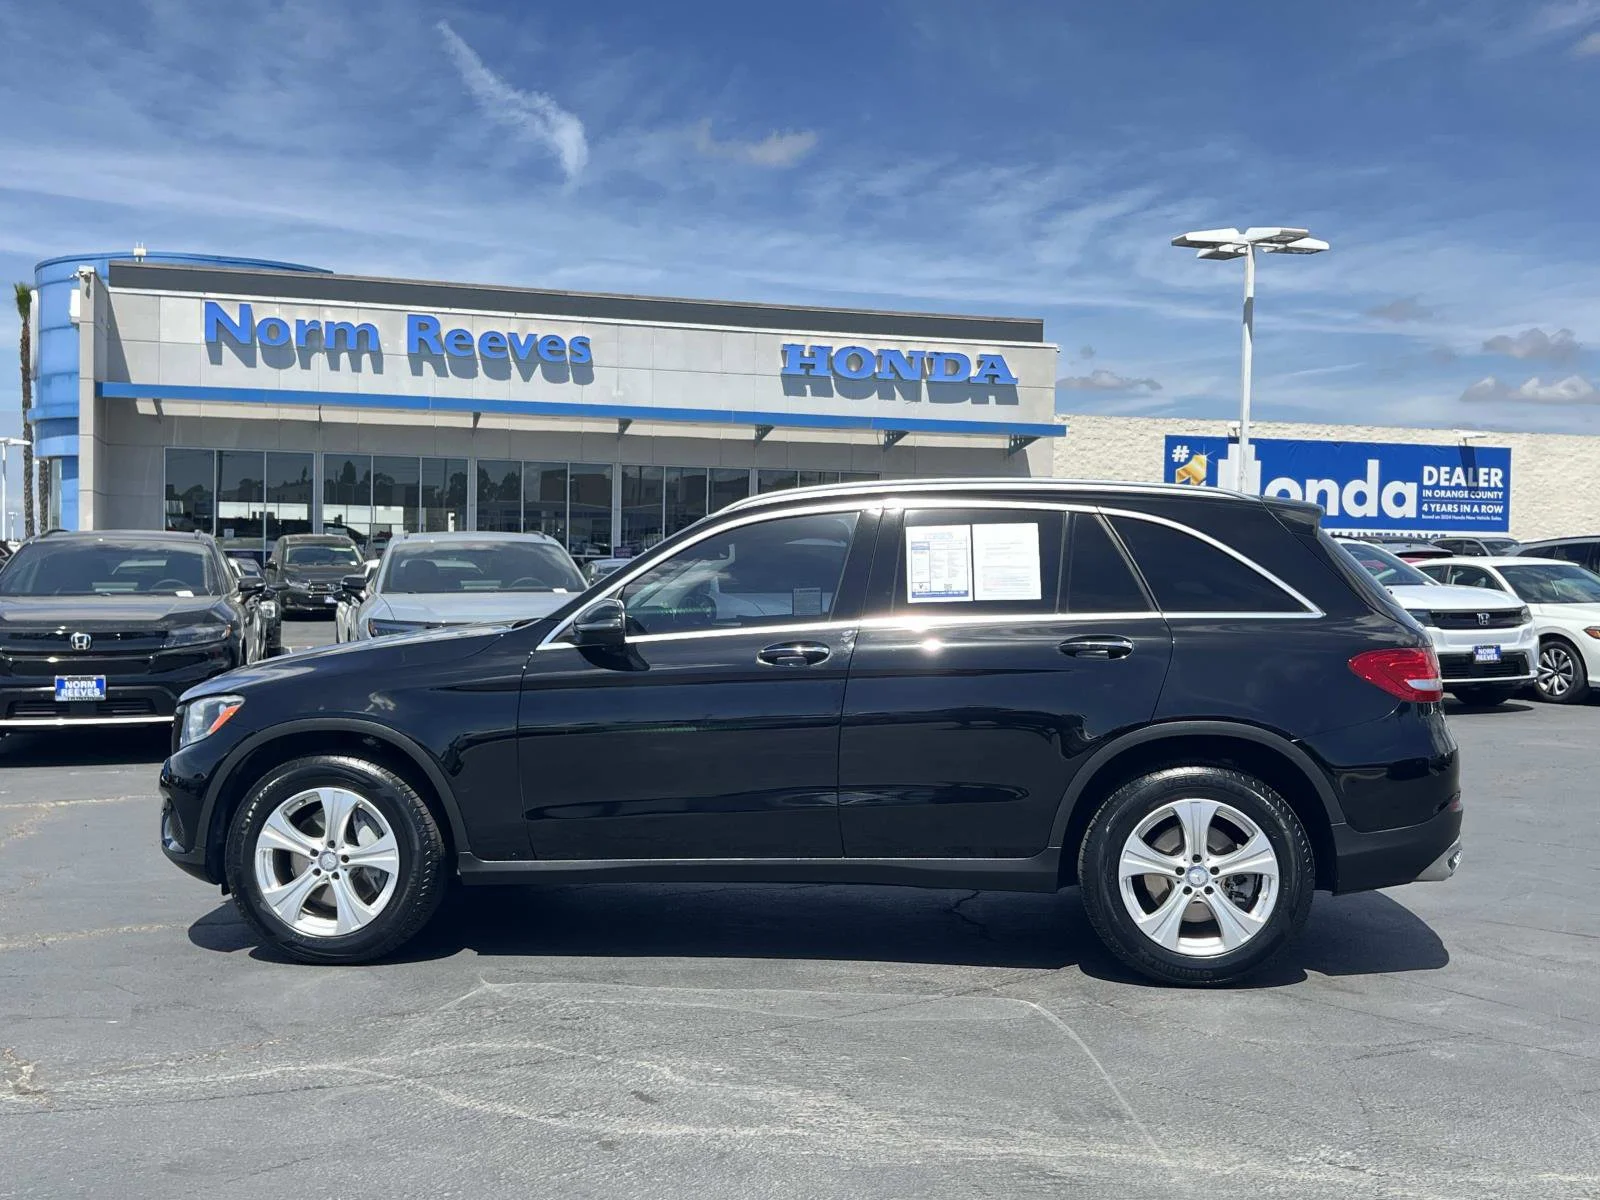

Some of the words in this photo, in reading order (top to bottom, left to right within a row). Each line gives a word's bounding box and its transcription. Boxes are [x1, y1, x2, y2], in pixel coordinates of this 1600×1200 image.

[205, 302, 379, 352] Norm
[407, 313, 592, 364] Reeves
[781, 343, 1019, 385] HONDA
[1423, 466, 1503, 488] DEALER
[1422, 489, 1432, 497] IN
[1434, 490, 1468, 498] ORANGE
[1470, 490, 1503, 499] COUNTY
[1422, 503, 1429, 512] 4
[1431, 504, 1458, 513] YEARS
[1460, 504, 1471, 513] IN
[1472, 504, 1480, 513] A
[1481, 505, 1503, 514] ROW
[61, 688, 100, 697] REEVES
